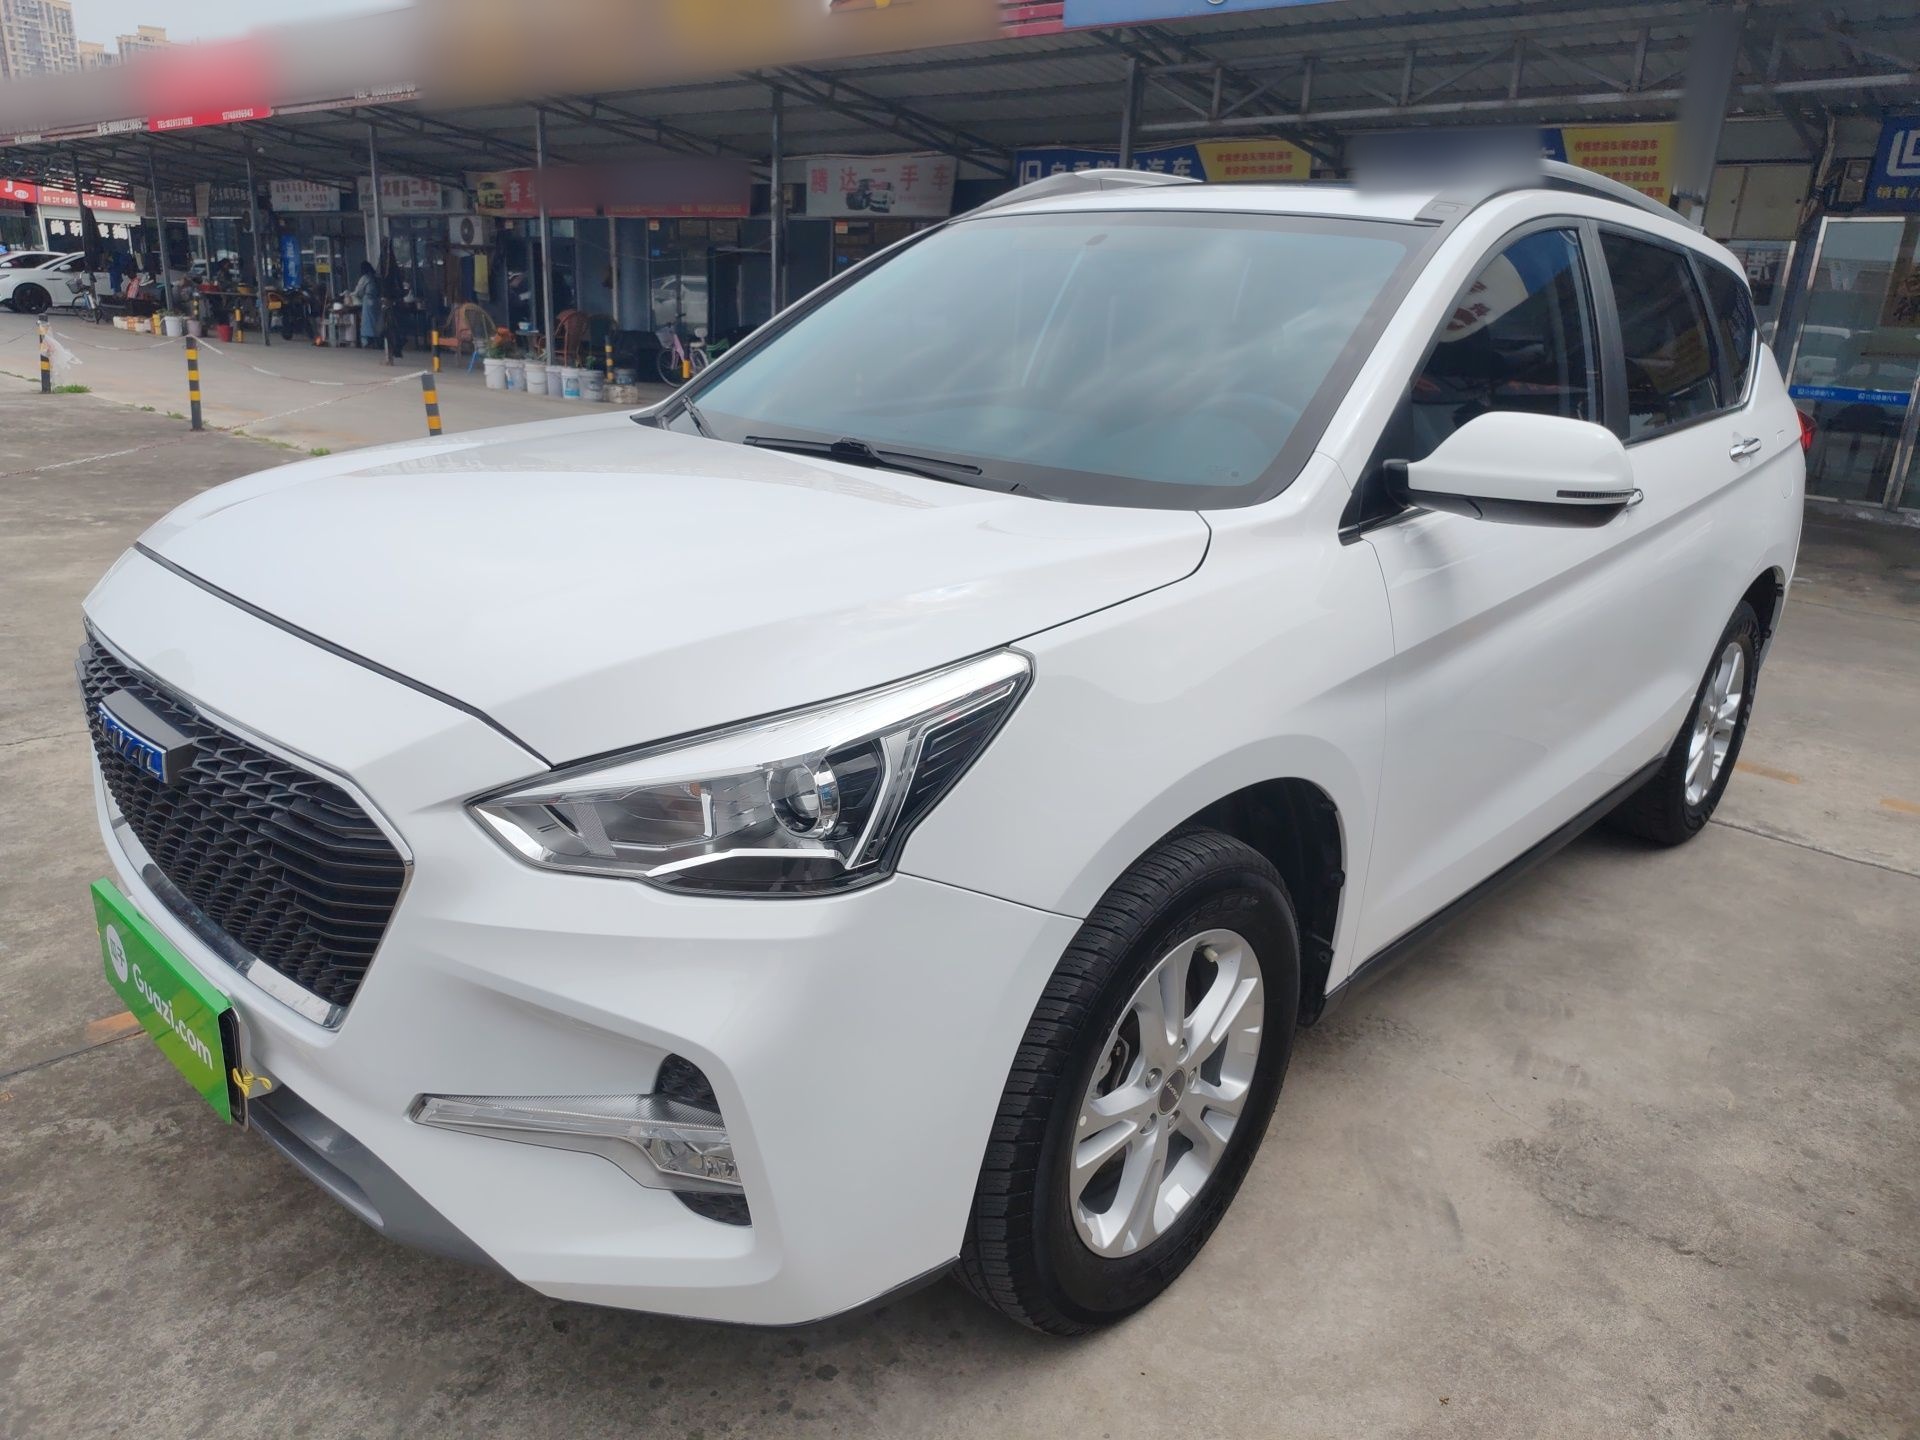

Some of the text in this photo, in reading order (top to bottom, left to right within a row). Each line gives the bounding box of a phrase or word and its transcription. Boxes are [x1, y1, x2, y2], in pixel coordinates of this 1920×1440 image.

[810, 164, 949, 194] 腾达二手车
[132, 963, 213, 1070] Guazi.com
